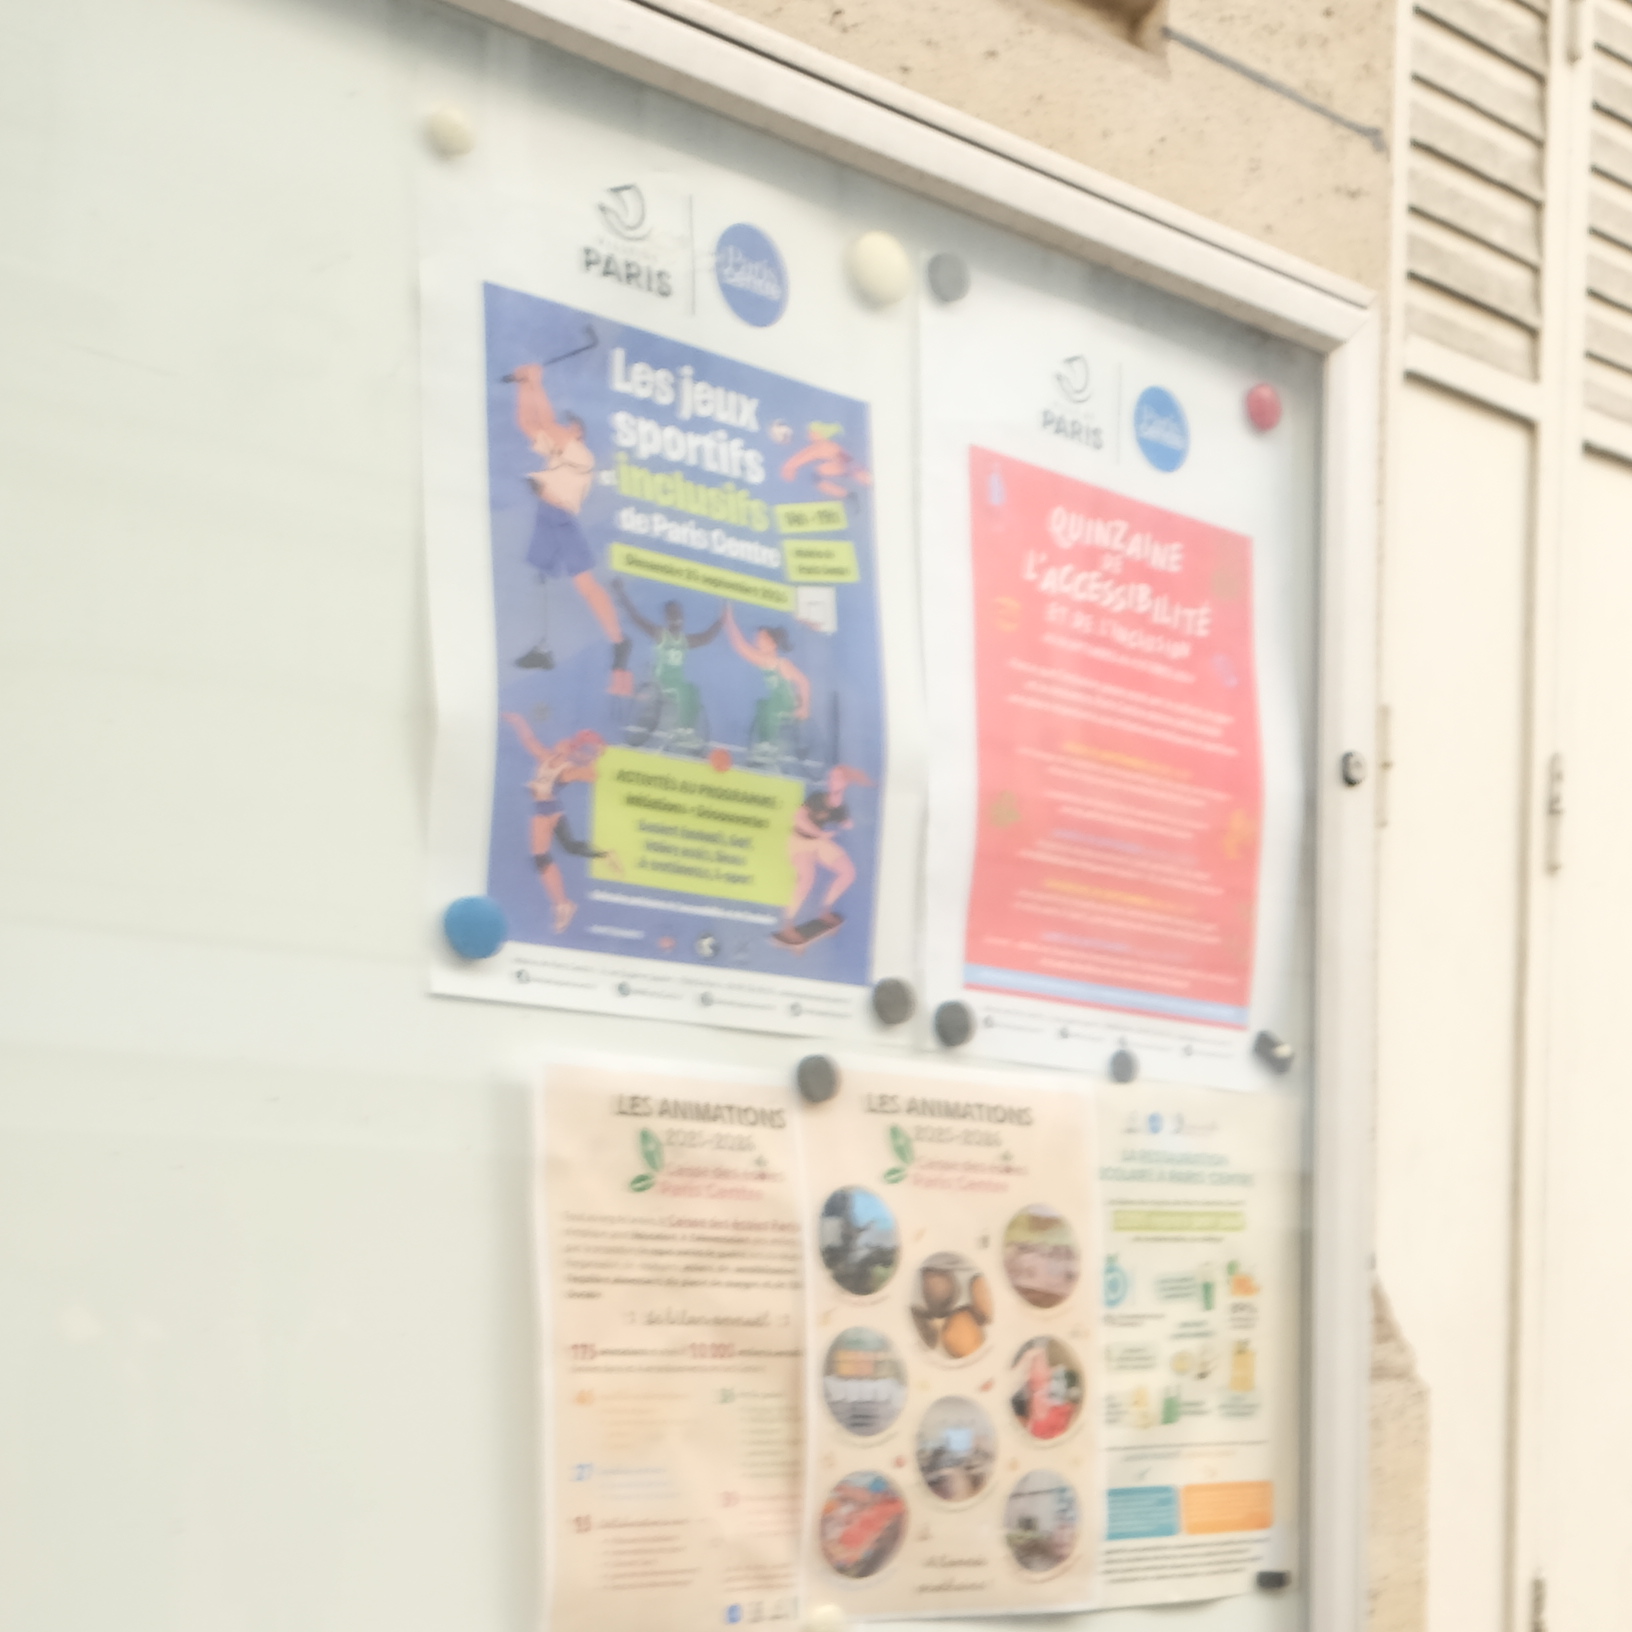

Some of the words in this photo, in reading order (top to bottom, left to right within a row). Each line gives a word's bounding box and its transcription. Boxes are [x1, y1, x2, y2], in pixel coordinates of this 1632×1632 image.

[582, 245, 672, 298] PARIS
[610, 347, 676, 405] Les
[677, 365, 760, 432] jeux
[610, 410, 766, 484] sportifs
[1041, 407, 1105, 451] PARIS
[615, 451, 769, 533] inclusifs
[651, 513, 709, 550] Paris
[1047, 505, 1184, 573] QUINZAINE
[1022, 549, 1213, 637] L'ACCESSIBILITÉ
[614, 1094, 652, 1117] LES
[657, 1098, 787, 1130] ANIMATIONS
[863, 1092, 900, 1114] LES
[905, 1095, 1034, 1127] ANIMATIONS
